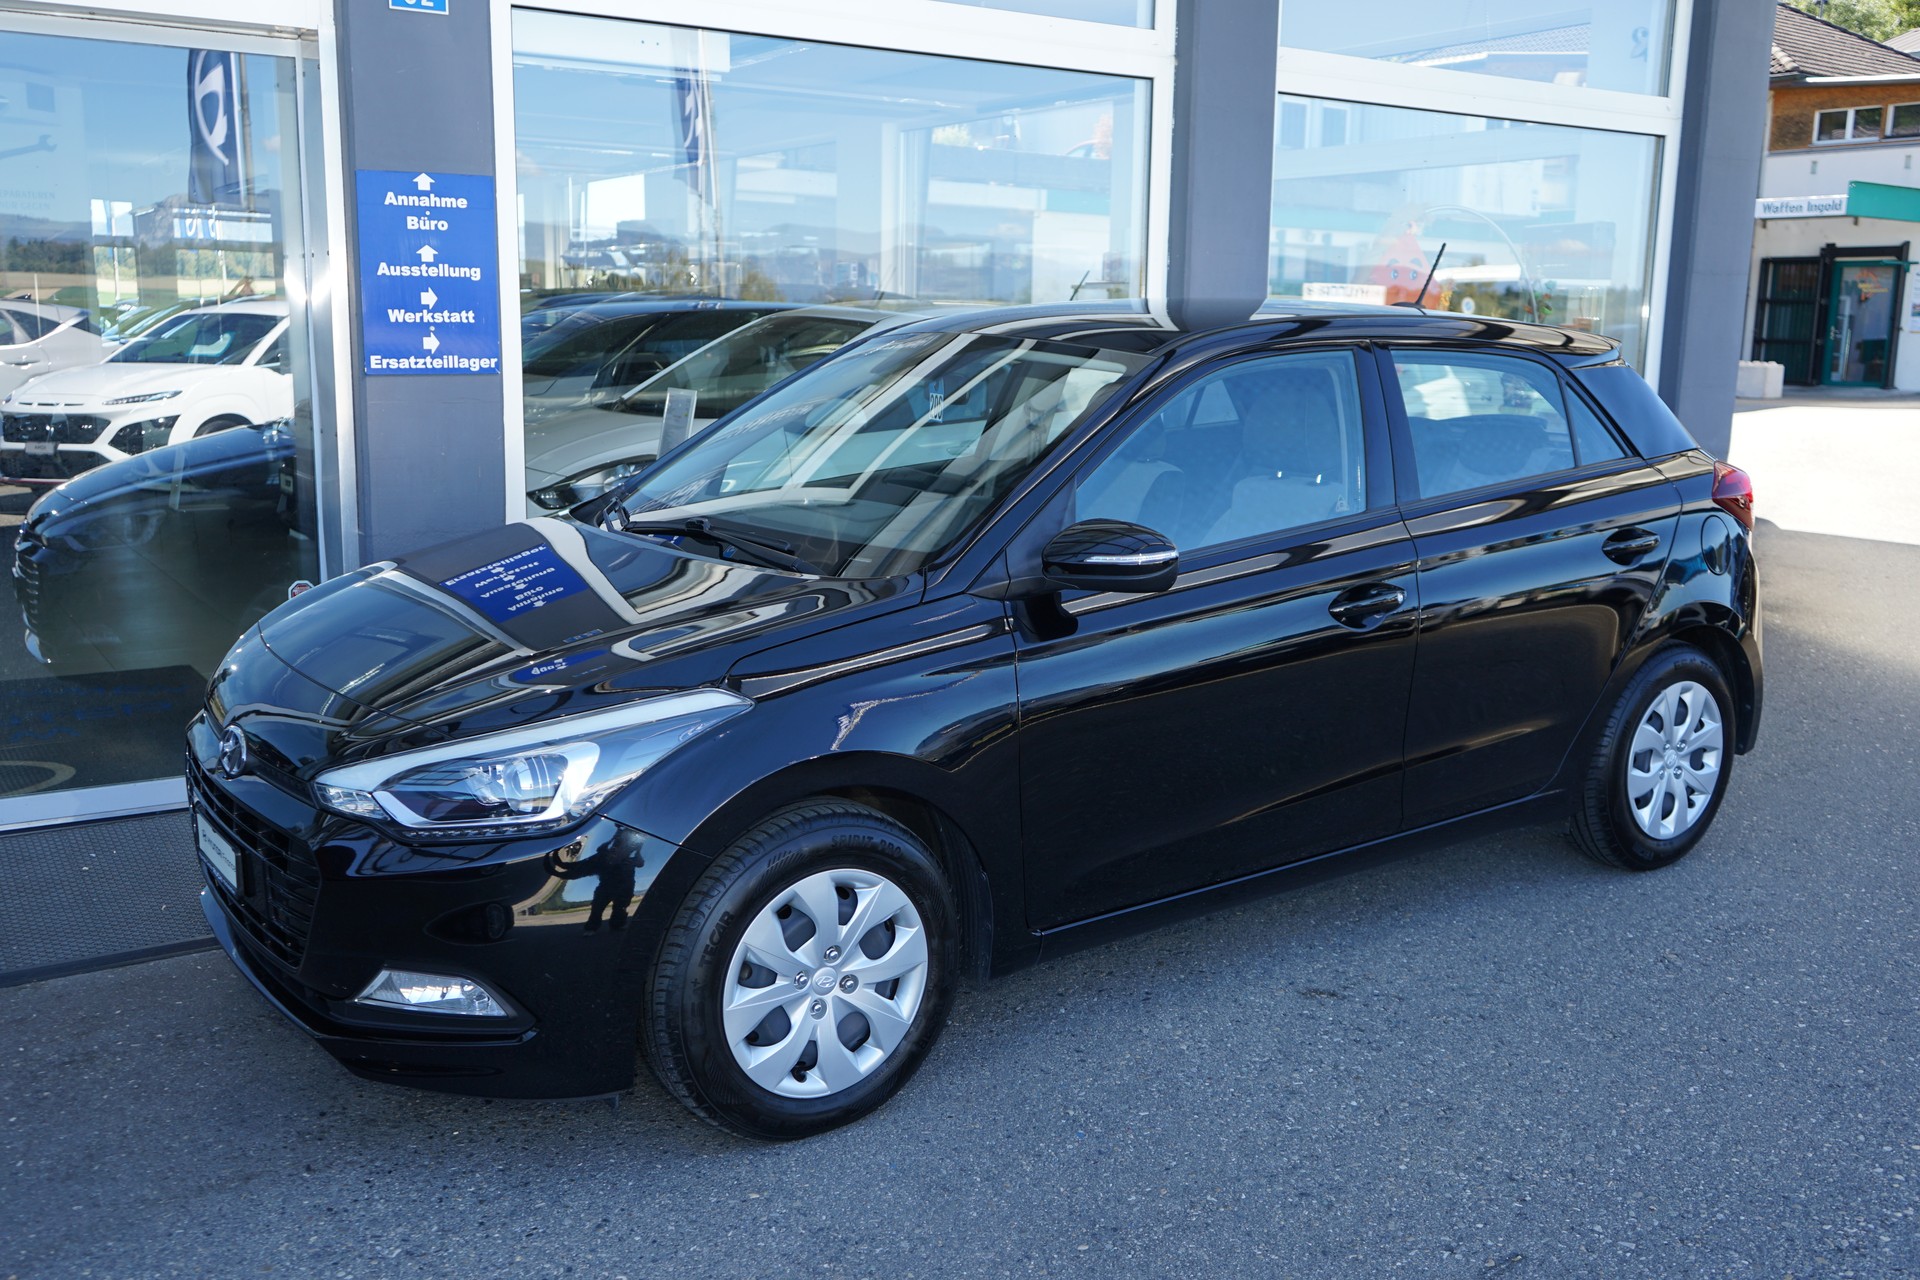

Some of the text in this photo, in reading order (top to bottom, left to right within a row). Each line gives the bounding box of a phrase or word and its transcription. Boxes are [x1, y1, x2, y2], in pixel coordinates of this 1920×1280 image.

[384, 192, 468, 209] Annahme
[1762, 199, 1843, 214] Waffen Ingold
[406, 216, 449, 231] Büro
[377, 262, 482, 281] Ausstellung
[387, 308, 475, 324] Werkstatt
[369, 354, 498, 371] Ersatzteillager
